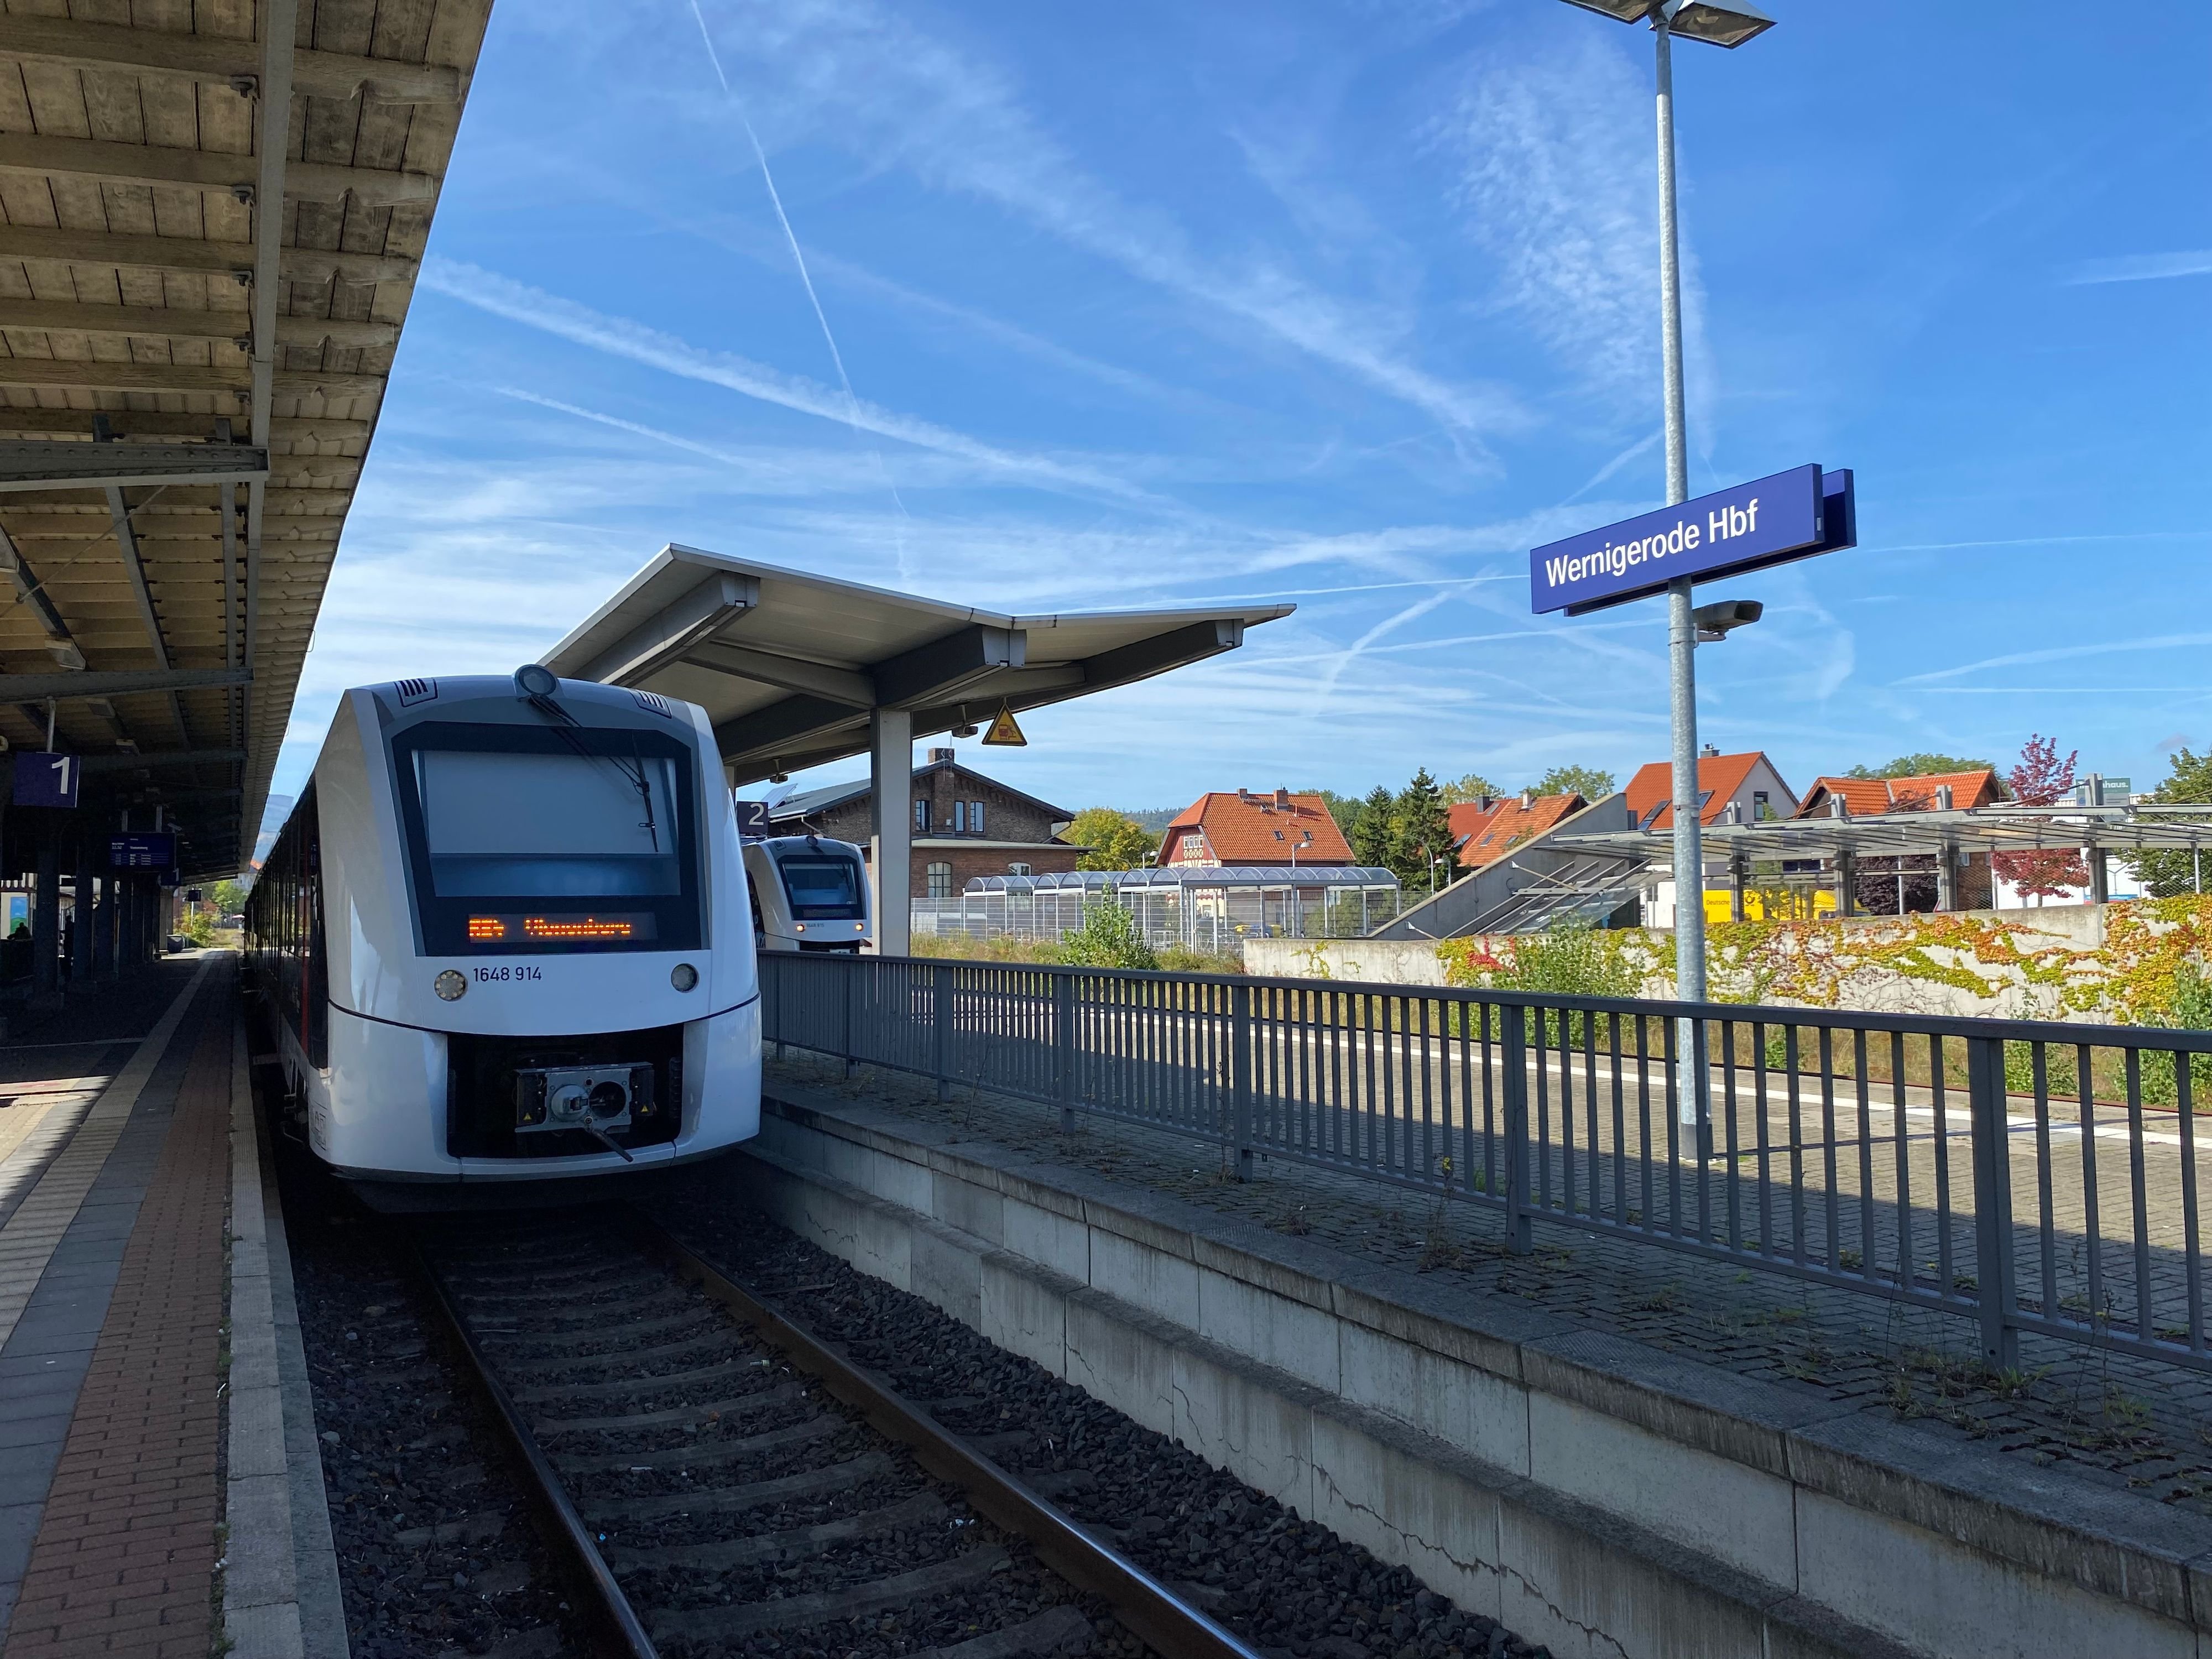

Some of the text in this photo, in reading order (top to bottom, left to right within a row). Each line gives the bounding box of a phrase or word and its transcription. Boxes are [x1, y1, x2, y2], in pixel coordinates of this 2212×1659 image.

[1545, 497, 1759, 587] Wernigerode Hbf
[51, 756, 71, 794] 1
[748, 802, 764, 826] 2
[173, 868, 179, 881] 1
[473, 967, 542, 982] 1648 914
